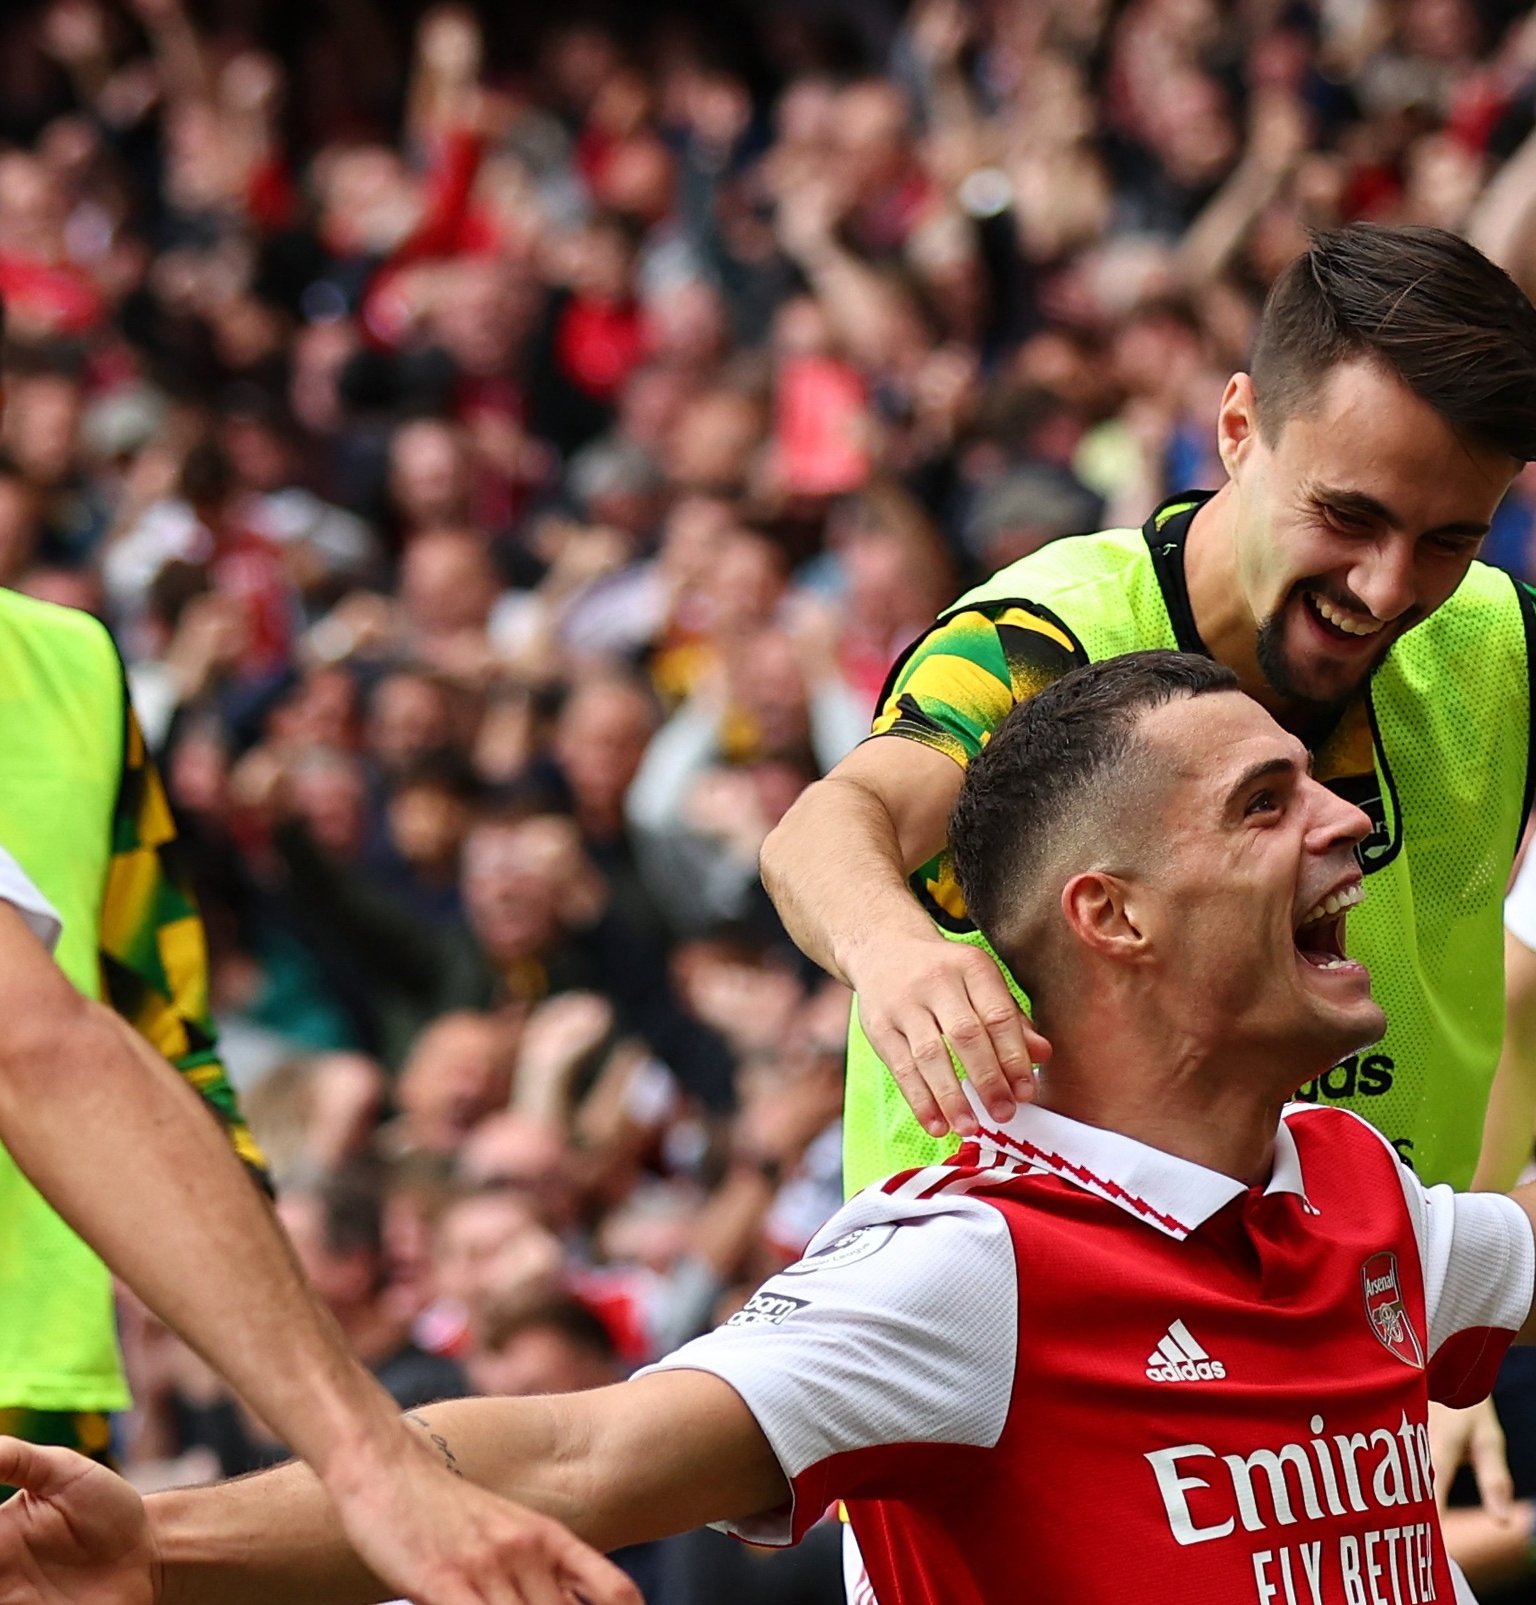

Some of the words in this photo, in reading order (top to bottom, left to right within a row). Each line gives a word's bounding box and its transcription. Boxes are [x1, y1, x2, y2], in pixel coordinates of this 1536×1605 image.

[1365, 1269, 1395, 1298] Arsenal
[1145, 1358, 1227, 1383] adidas
[1143, 1408, 1434, 1546] Emirate
